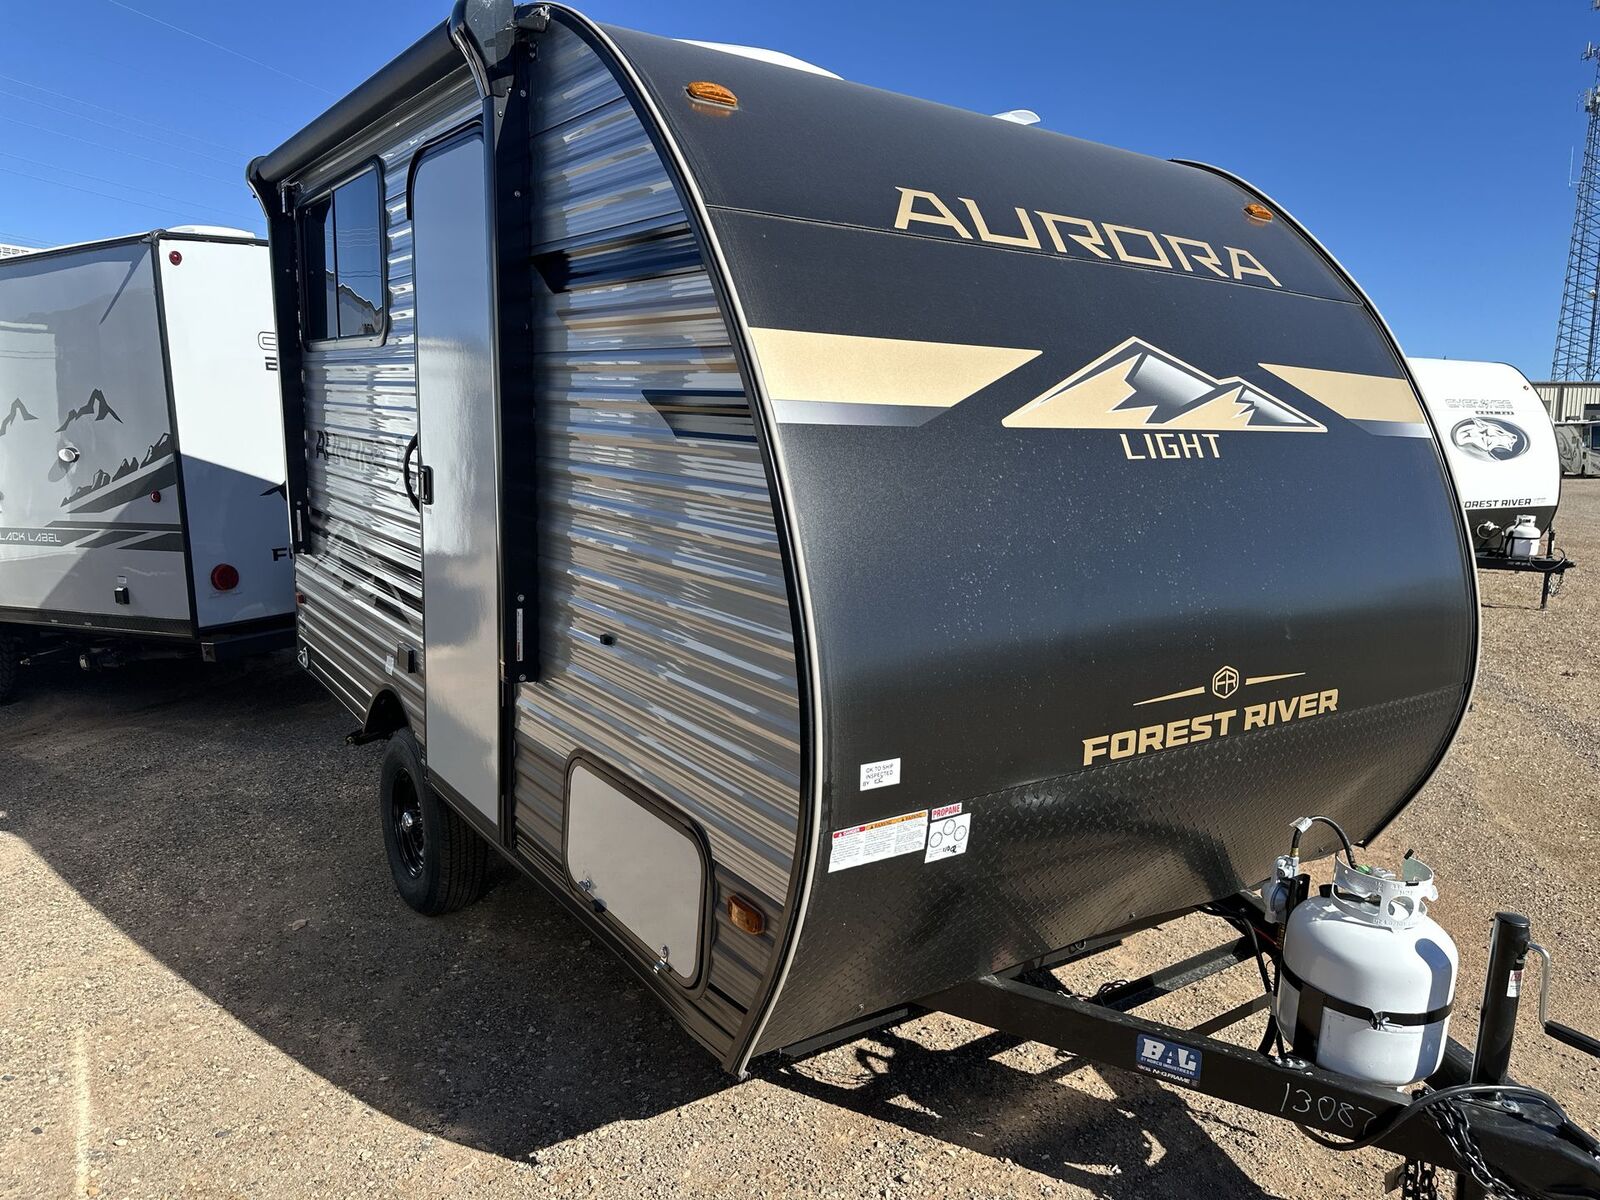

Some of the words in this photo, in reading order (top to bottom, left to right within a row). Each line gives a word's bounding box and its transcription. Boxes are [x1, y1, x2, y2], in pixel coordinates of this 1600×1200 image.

[895, 186, 1282, 287] AURORA
[1120, 433, 1220, 459] LIGHT
[1463, 500, 1499, 508] OREST
[1501, 498, 1532, 507] RIVER
[28, 533, 61, 542] LABEL
[1082, 709, 1237, 766] FOREST
[1244, 688, 1339, 731] RIVER
[932, 804, 960, 818] PROPANE
[1280, 1083, 1377, 1136] 13087
